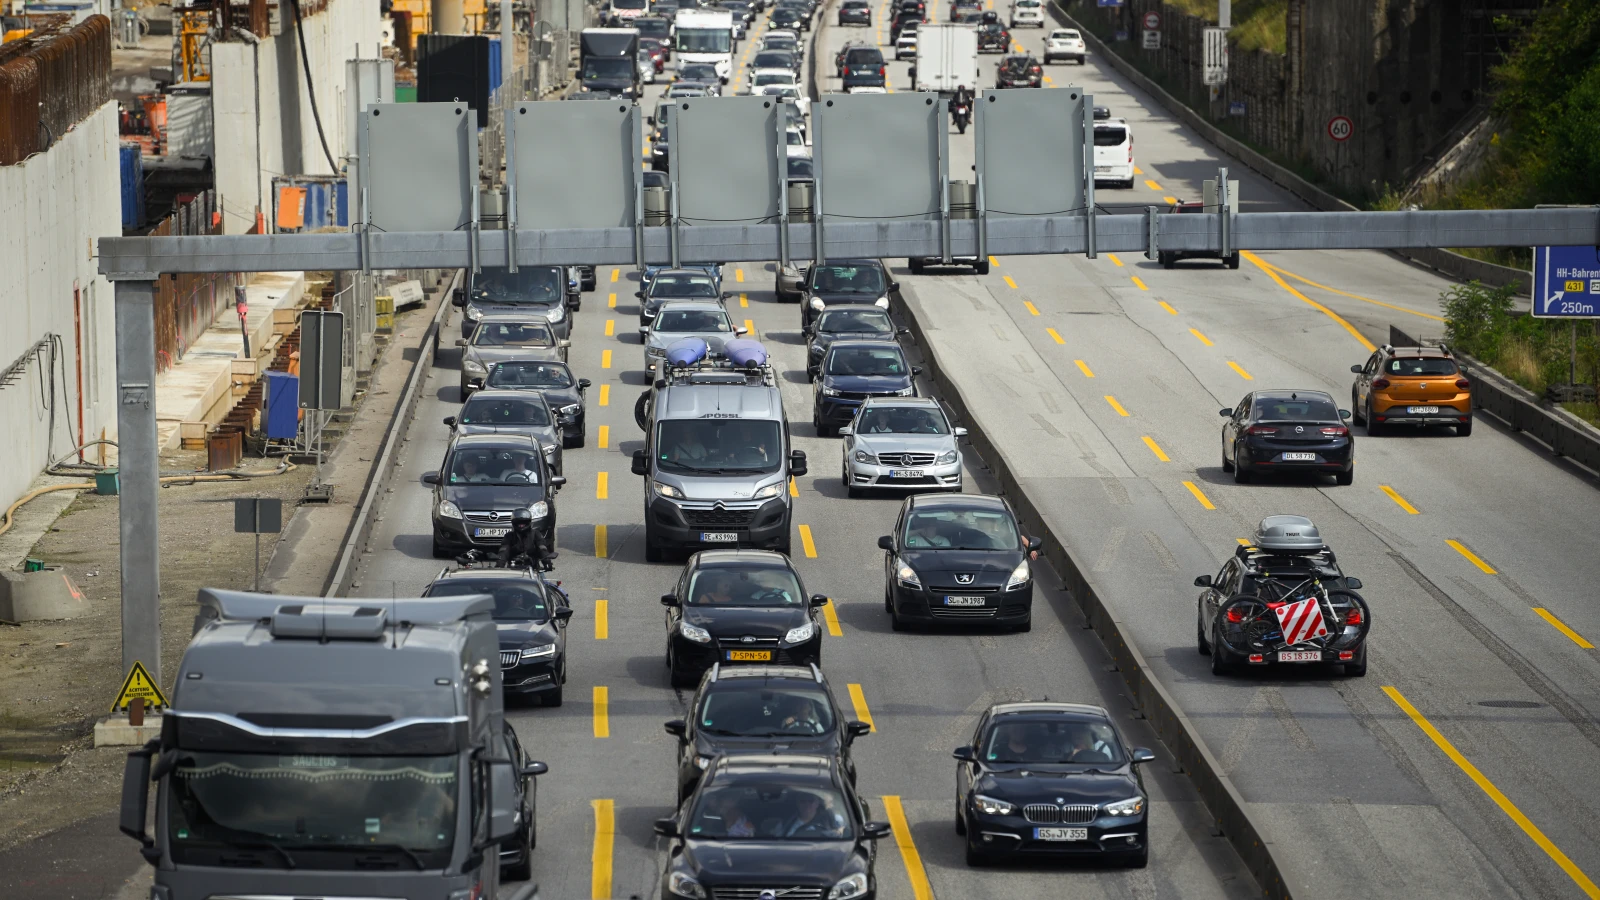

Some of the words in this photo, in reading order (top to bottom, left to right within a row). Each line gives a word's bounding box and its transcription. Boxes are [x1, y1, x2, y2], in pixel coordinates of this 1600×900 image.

[1333, 122, 1348, 135] 60
[1556, 268, 1600, 278] HH-Bahren
[1567, 282, 1582, 291] 431
[1561, 302, 1594, 313] 250m
[1281, 652, 1292, 660] BS
[1294, 652, 1303, 660] 18
[1304, 652, 1318, 660] 376
[1039, 829, 1051, 838] GS
[1056, 829, 1069, 838] JY
[1069, 829, 1086, 839] 355
